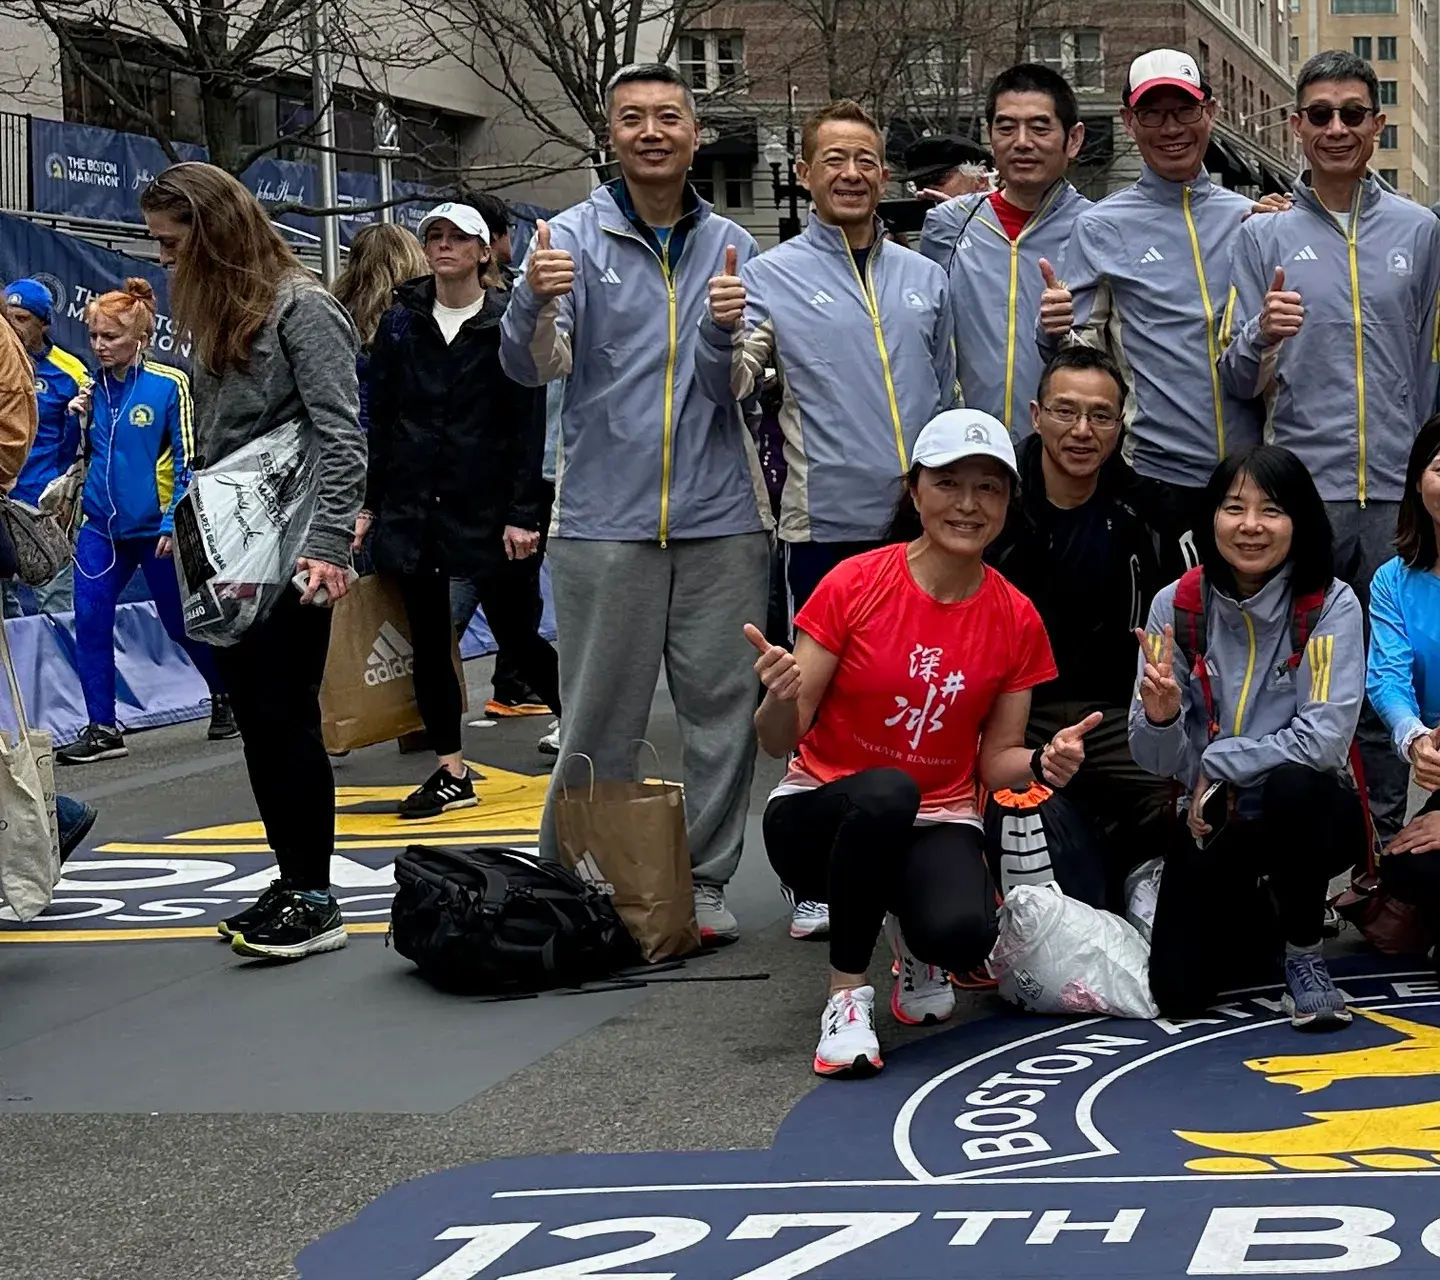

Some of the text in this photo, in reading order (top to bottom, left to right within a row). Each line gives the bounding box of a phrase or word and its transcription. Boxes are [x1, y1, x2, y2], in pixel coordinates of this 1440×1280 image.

[67, 155, 118, 175] THE BOSTON
[74, 285, 100, 302] TH
[364, 656, 413, 686] adida
[953, 1033, 1149, 1161] BOSTON
